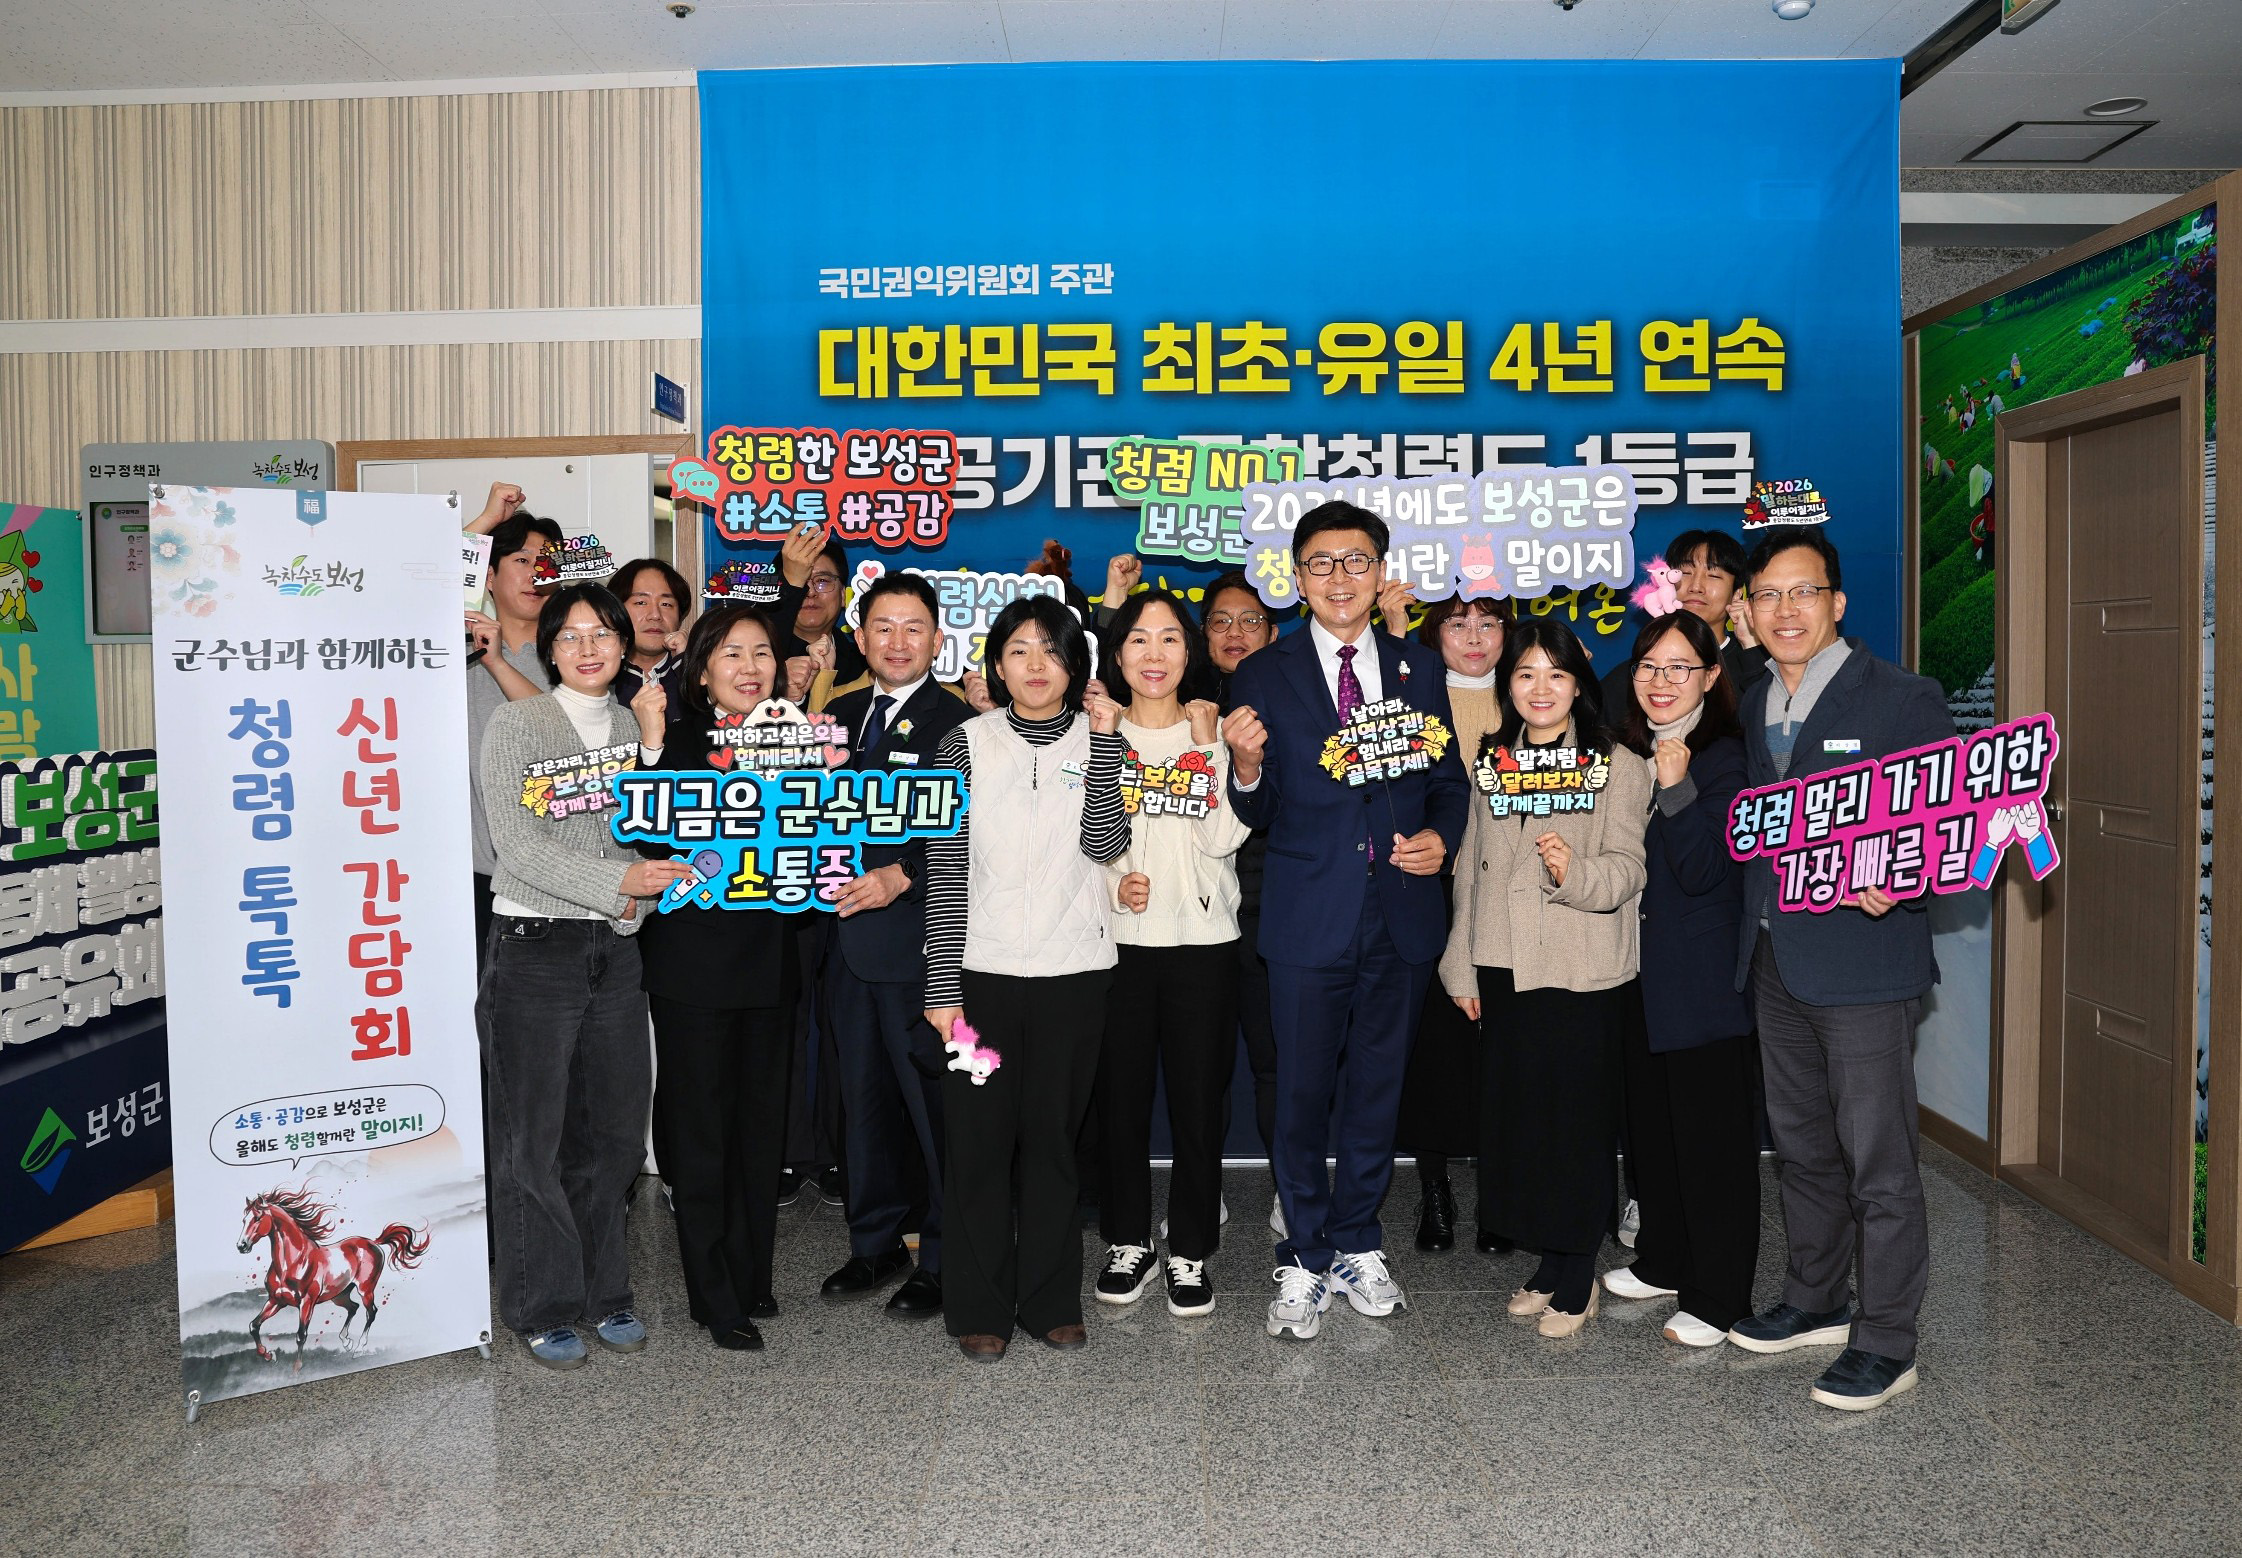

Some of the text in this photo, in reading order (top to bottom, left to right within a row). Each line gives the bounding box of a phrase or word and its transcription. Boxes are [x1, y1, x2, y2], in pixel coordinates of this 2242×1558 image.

[818, 263, 1115, 298] 국민권익위원회 주관
[818, 317, 1786, 398] 대한민국 최초·유일 4년 연속
[89, 463, 161, 478] 인구정책과
[252, 457, 319, 481] 녹차수도 보성
[717, 434, 952, 483] 청렴한 보성군
[950, 435, 1146, 508] 공기관
[1576, 431, 1755, 505] 1등급
[1113, 445, 1297, 494] 청렴 NO.1
[1251, 474, 1627, 531] 20년에도 보성군은
[1760, 491, 1822, 509] 말하는대로
[1775, 478, 1813, 494] 2026
[303, 499, 320, 514] 福
[724, 492, 945, 538] #소통 #공감
[563, 535, 599, 551] 2026
[261, 560, 364, 593] 녹차수도 보성
[743, 562, 776, 574] 2026
[1507, 539, 1623, 586] 말이지
[172, 637, 450, 671] 군수님과 함께하는
[1338, 711, 1425, 745] 지역상권!
[1350, 698, 1404, 724] 날아라
[706, 724, 849, 746] 기억하고싶은오늘
[1358, 736, 1410, 762] 힘내라
[734, 747, 822, 770] 함께라서
[1346, 751, 1430, 786] 골목경제!
[1515, 747, 1577, 771] 말처럼
[1120, 763, 1210, 797] 는,보성을
[1501, 771, 1584, 794] 달려보자
[1732, 726, 2048, 851] 청렴 멀리 가기 위한
[8, 760, 160, 862] 보성군
[549, 791, 615, 819] 함께갑
[621, 780, 958, 838] 지금은 군수님과
[1120, 785, 1209, 818] 랑합니다
[228, 697, 301, 1009] 청렴 톡톡
[1780, 816, 1974, 901] 가장 빠른 길
[337, 696, 412, 1062] 신년 간담회
[728, 848, 857, 902] 소통중
[2, 916, 166, 1045] 공유회
[85, 1081, 164, 1150] 보성군
[333, 1097, 387, 1117] 보성군은
[235, 1138, 279, 1158] 올해도
[361, 1113, 424, 1141] 말이지!
